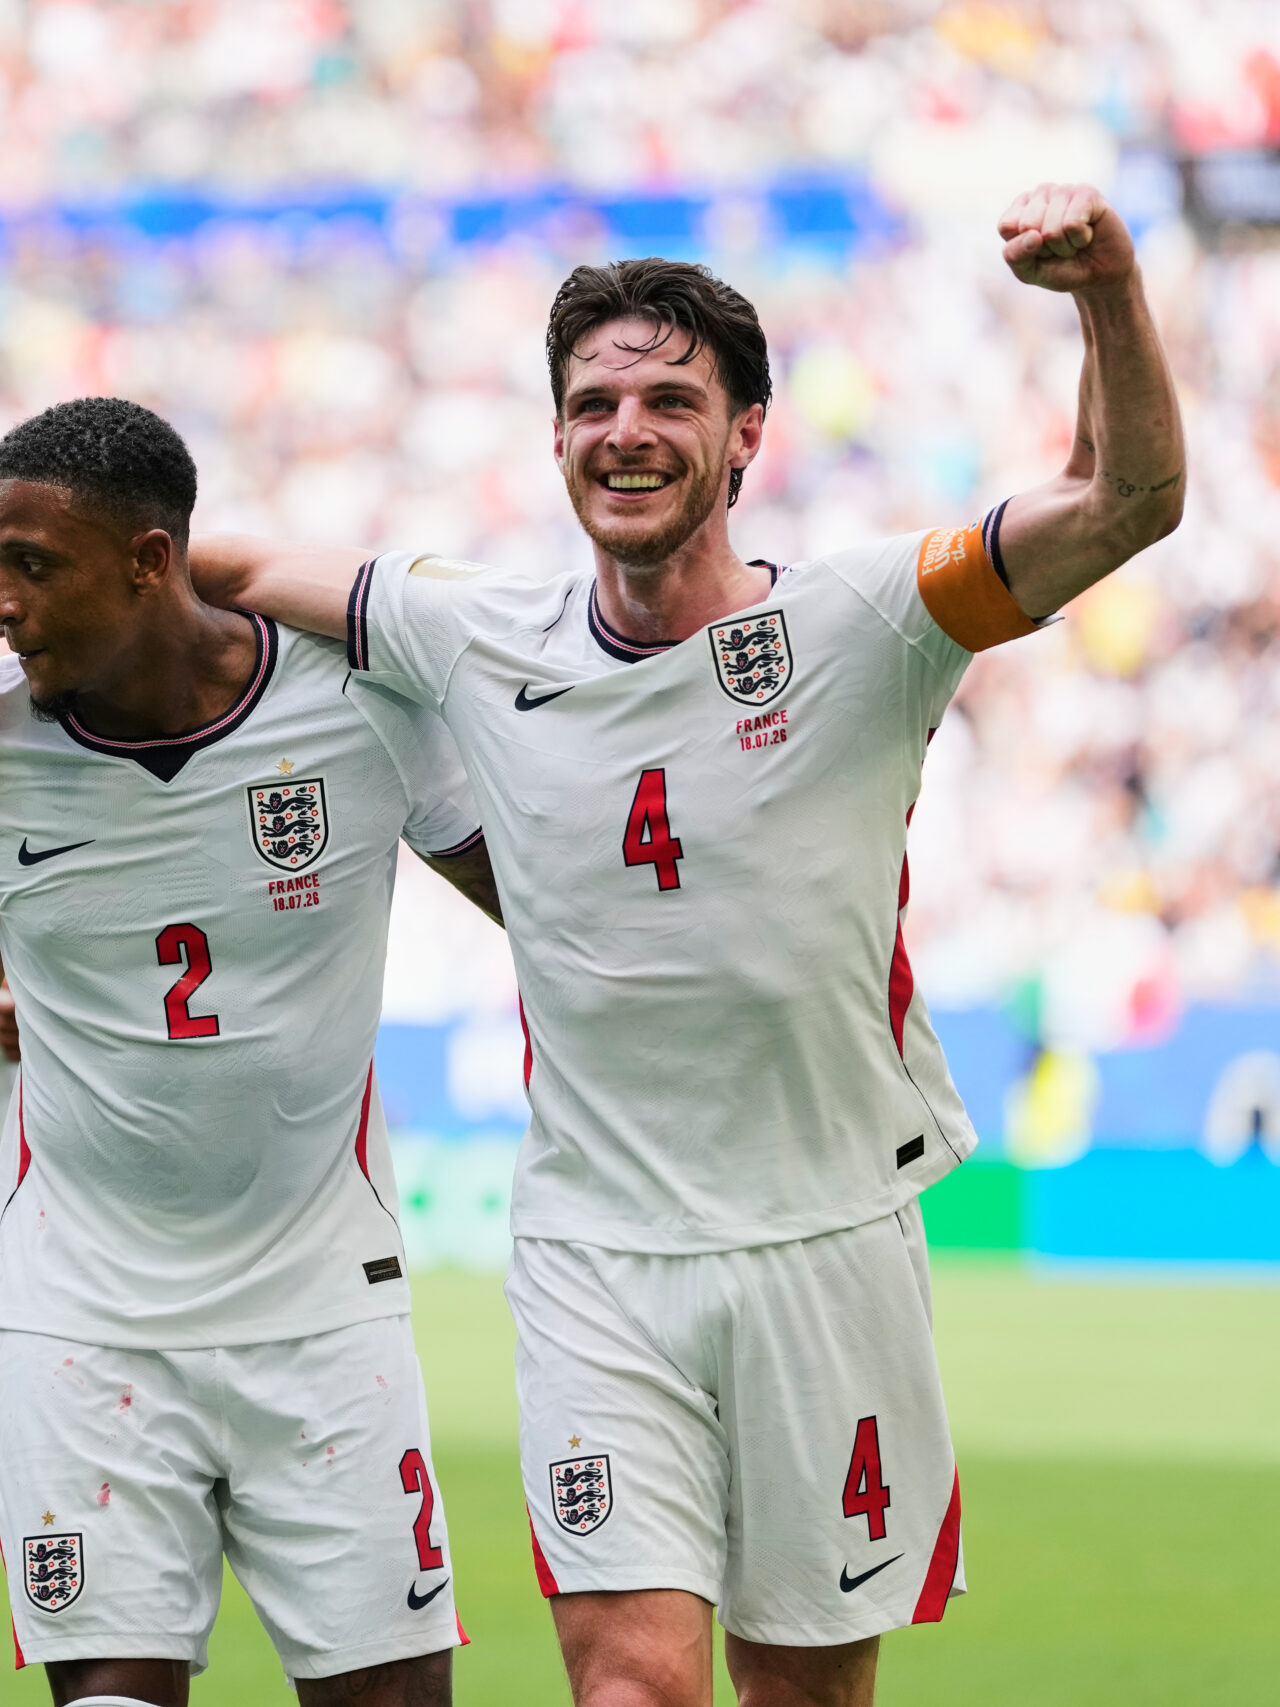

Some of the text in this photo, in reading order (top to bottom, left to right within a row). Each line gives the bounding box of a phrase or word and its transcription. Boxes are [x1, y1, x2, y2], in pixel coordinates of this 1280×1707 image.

[736, 709, 788, 734] FRANCE
[740, 728, 787, 751] 18.07.26
[622, 768, 684, 892] 4
[268, 873, 320, 895] FRANCE
[272, 891, 320, 911] 18.07.26
[155, 922, 220, 1040] 2
[398, 1448, 444, 1572] 2
[842, 1415, 891, 1542] 4
